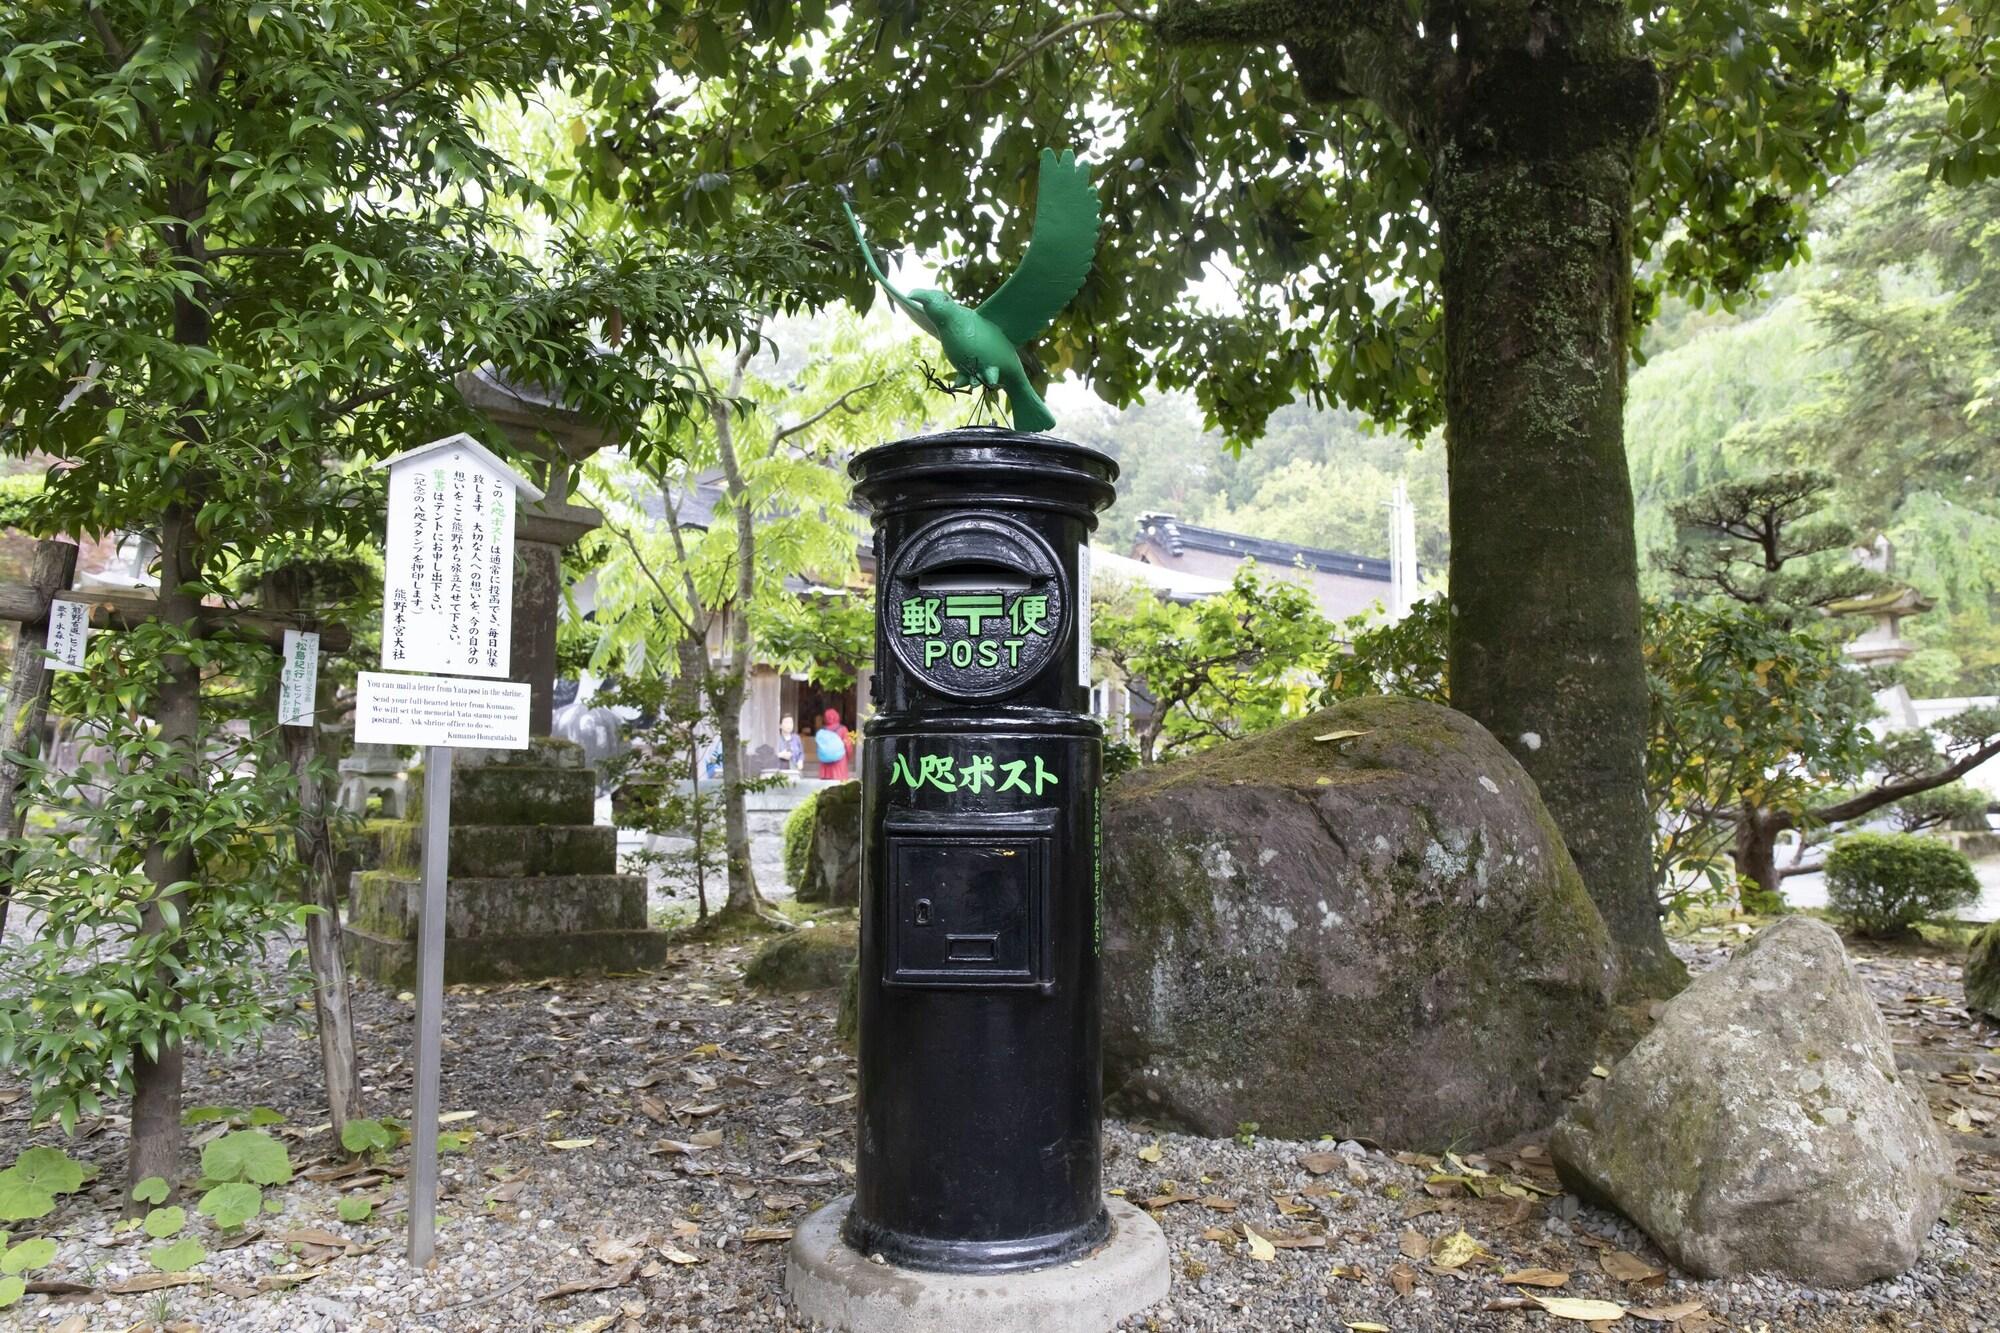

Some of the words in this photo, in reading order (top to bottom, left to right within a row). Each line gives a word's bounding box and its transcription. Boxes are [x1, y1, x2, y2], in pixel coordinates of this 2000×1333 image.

[391, 587, 407, 661] 熊野本宮大社
[924, 639, 1025, 669] POST
[367, 679, 380, 687] You
[396, 681, 411, 689] mail
[417, 683, 435, 691] letter
[436, 684, 451, 692] from
[452, 685, 467, 693] Yata
[423, 708, 454, 716] memorial
[447, 731, 475, 739] Kumano
[889, 753, 1059, 796] 八咫ポスト
